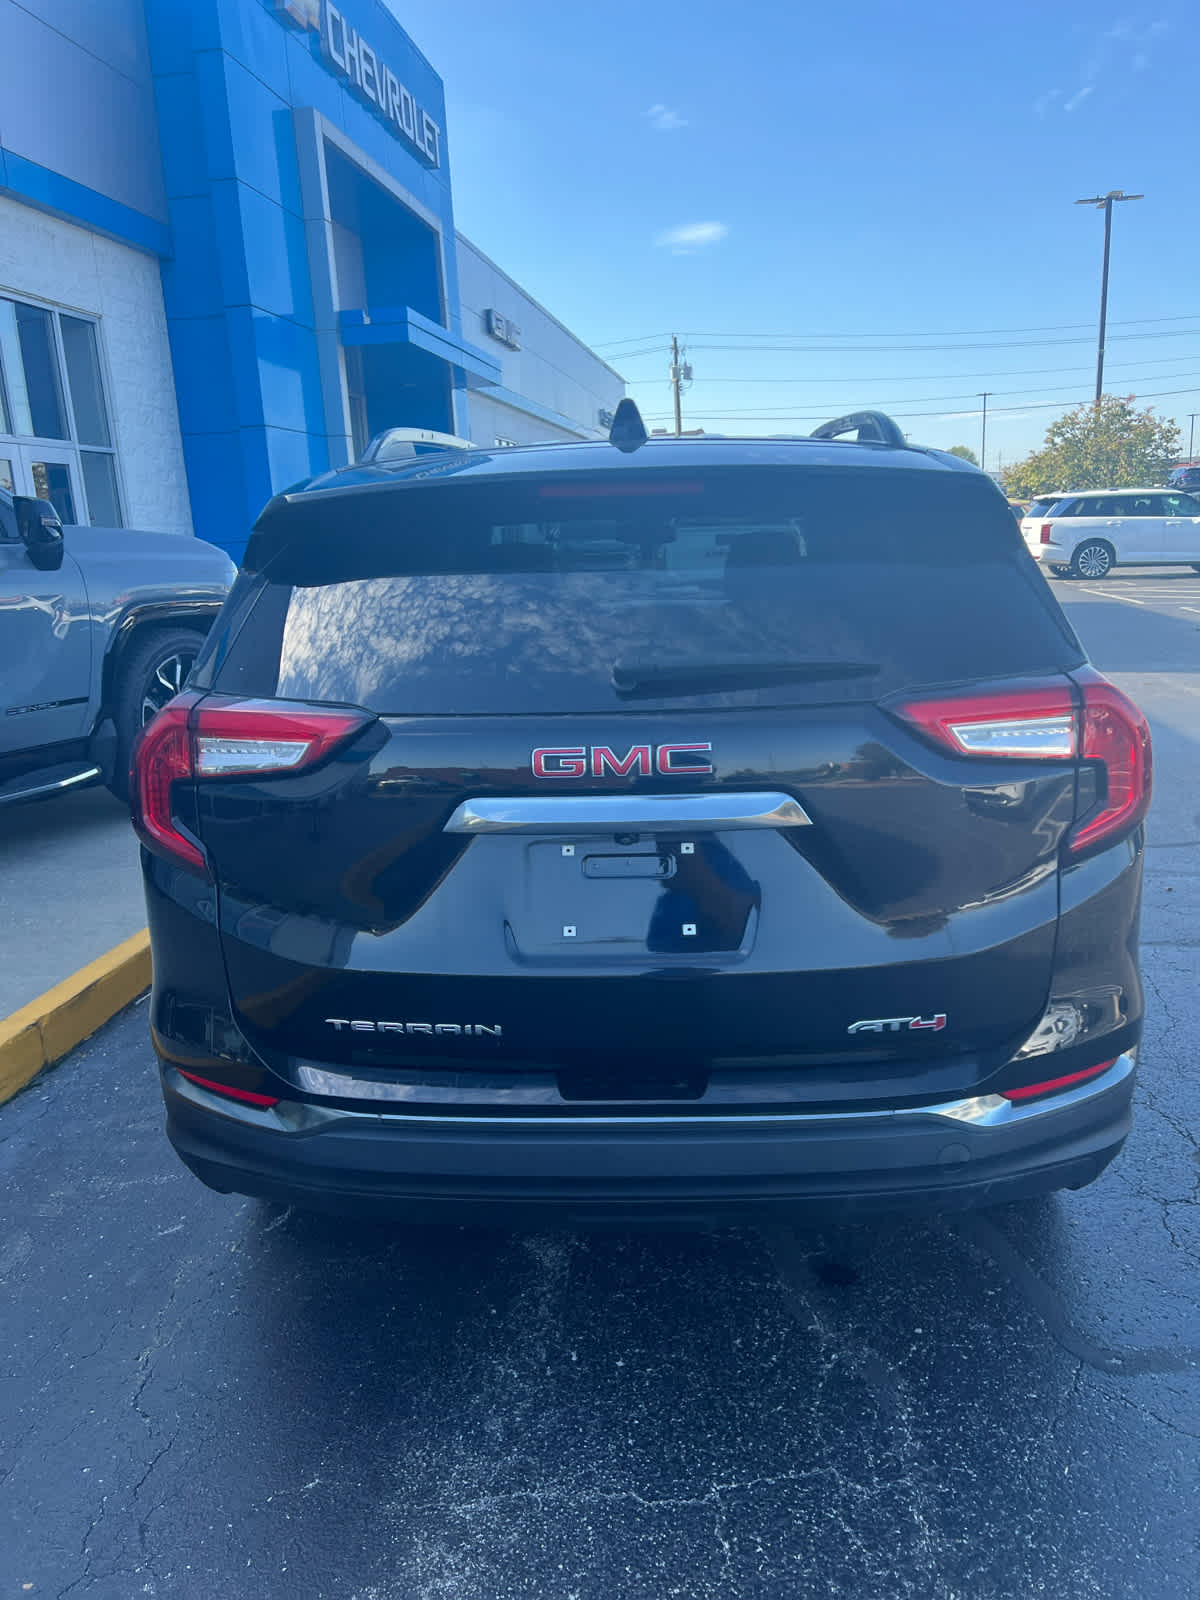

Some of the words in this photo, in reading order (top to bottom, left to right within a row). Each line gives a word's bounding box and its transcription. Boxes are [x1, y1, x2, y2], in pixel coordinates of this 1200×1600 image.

[325, 0, 441, 169] CHEVROLET
[531, 742, 713, 778] GMC
[325, 1018, 502, 1036] TERRAIN
[847, 1013, 947, 1034] AT4
